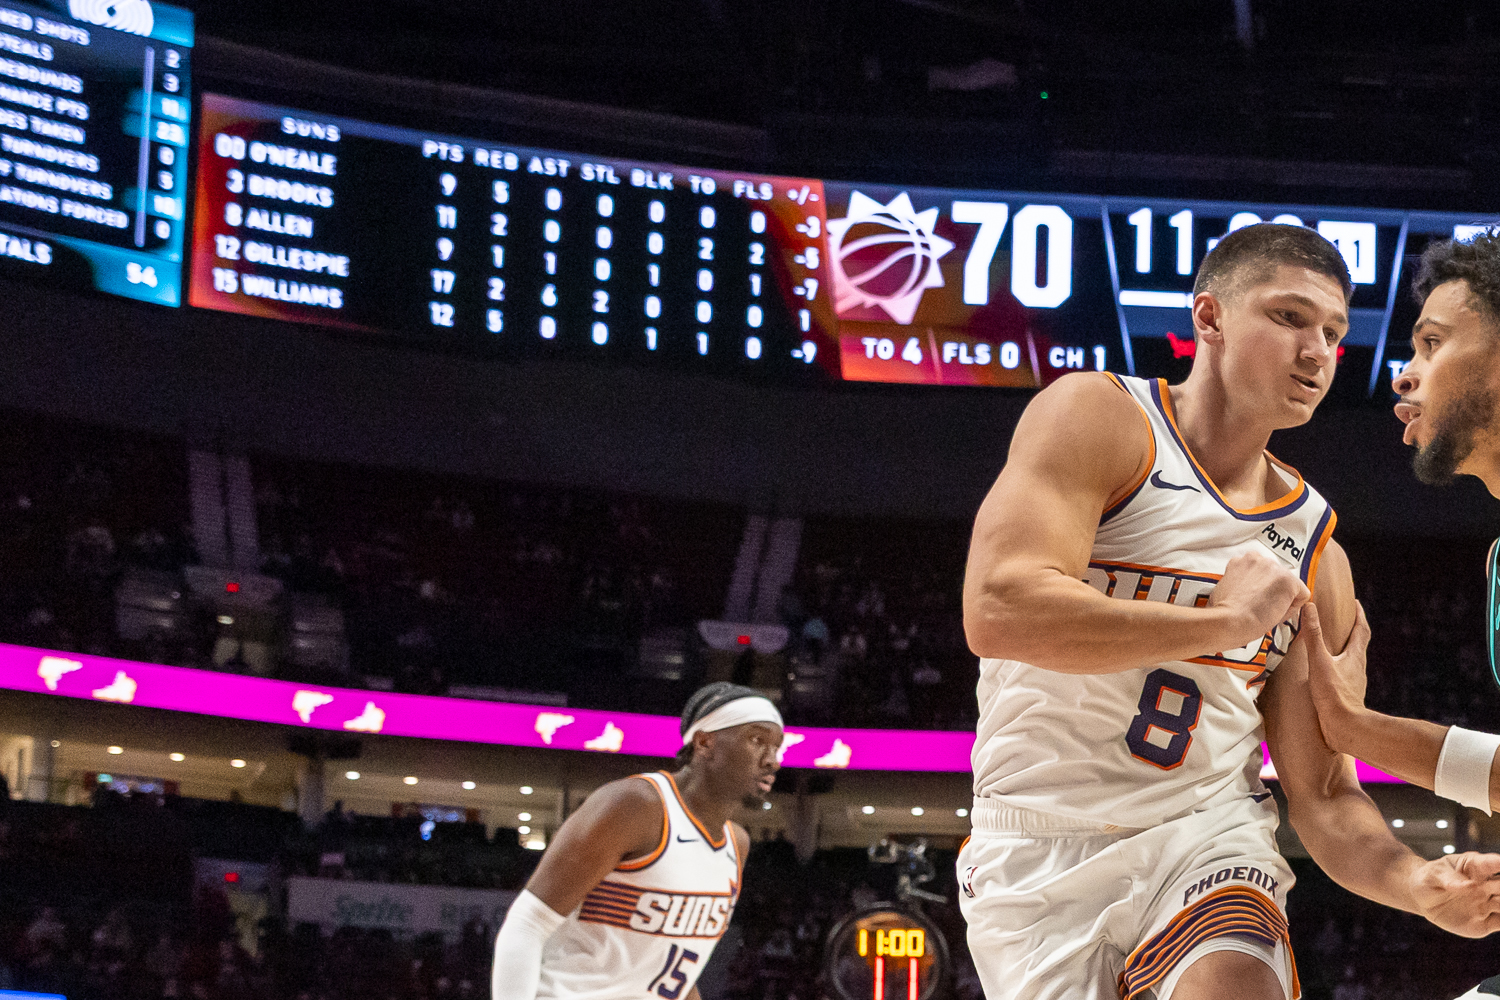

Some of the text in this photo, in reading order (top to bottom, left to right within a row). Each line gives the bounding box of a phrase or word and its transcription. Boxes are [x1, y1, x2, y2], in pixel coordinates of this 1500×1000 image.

[282, 116, 341, 142] SUNS
[215, 133, 821, 239] 00 O'NEALE 9 5 0 0 0 0 0 -3
[423, 139, 773, 201] PTS REB AST STL BLK TO FLS
[225, 202, 819, 301] 8 ALLEN 9 1 1 0 1 0 1 -7
[227, 169, 820, 270] 3 BROOKS 11 2 0 0 0 2 2 -5
[951, 200, 1073, 309] 70
[213, 267, 817, 364] 15 WILLIAMS 12 5 0 0 1 1 0 -9
[215, 234, 810, 332] 12 GILLESPIE 17 2 6 2 0 0 0 1
[861, 337, 1106, 372] TO 4 FLS 0 CH 1
[1261, 522, 1304, 562] PayPal
[1125, 668, 1203, 771] 8
[629, 890, 728, 938] SUNS
[1183, 864, 1279, 908] PHOENIX
[858, 928, 925, 957] 11:00
